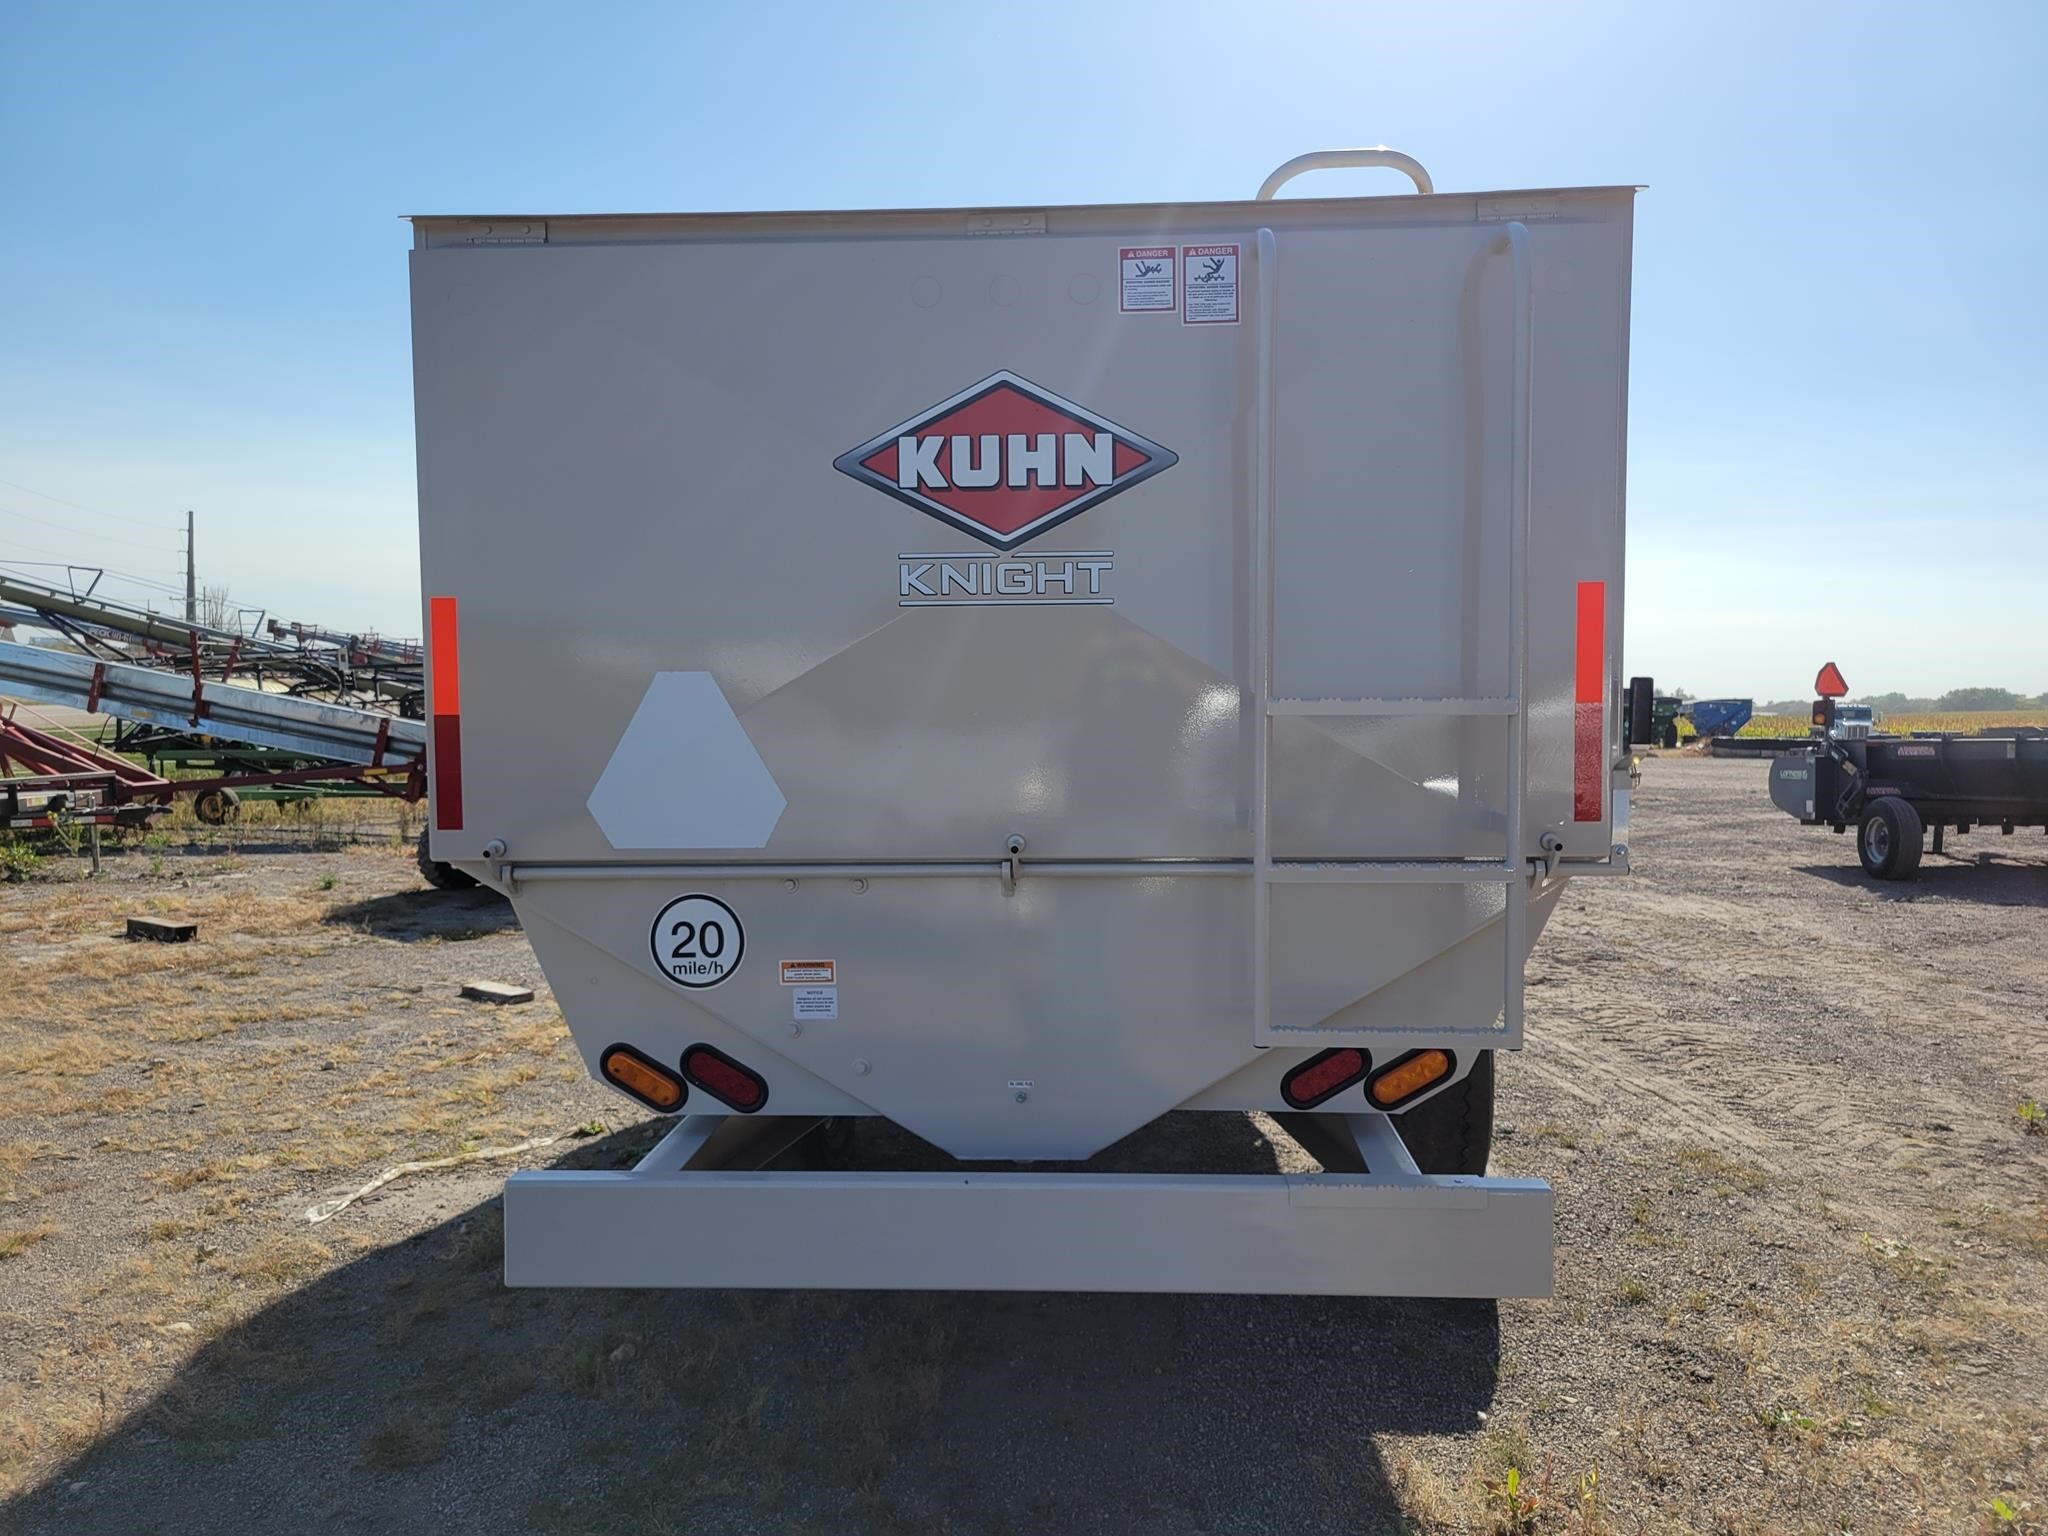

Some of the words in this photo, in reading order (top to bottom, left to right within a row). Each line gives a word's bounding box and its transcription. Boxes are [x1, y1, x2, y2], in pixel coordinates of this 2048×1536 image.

[1135, 249, 1168, 257] DANGER
[1197, 247, 1233, 256] DANGER
[897, 432, 1114, 490] KUHN
[899, 561, 1114, 596] KNIGHT
[671, 920, 725, 959] 20
[672, 960, 724, 975] mile/h
